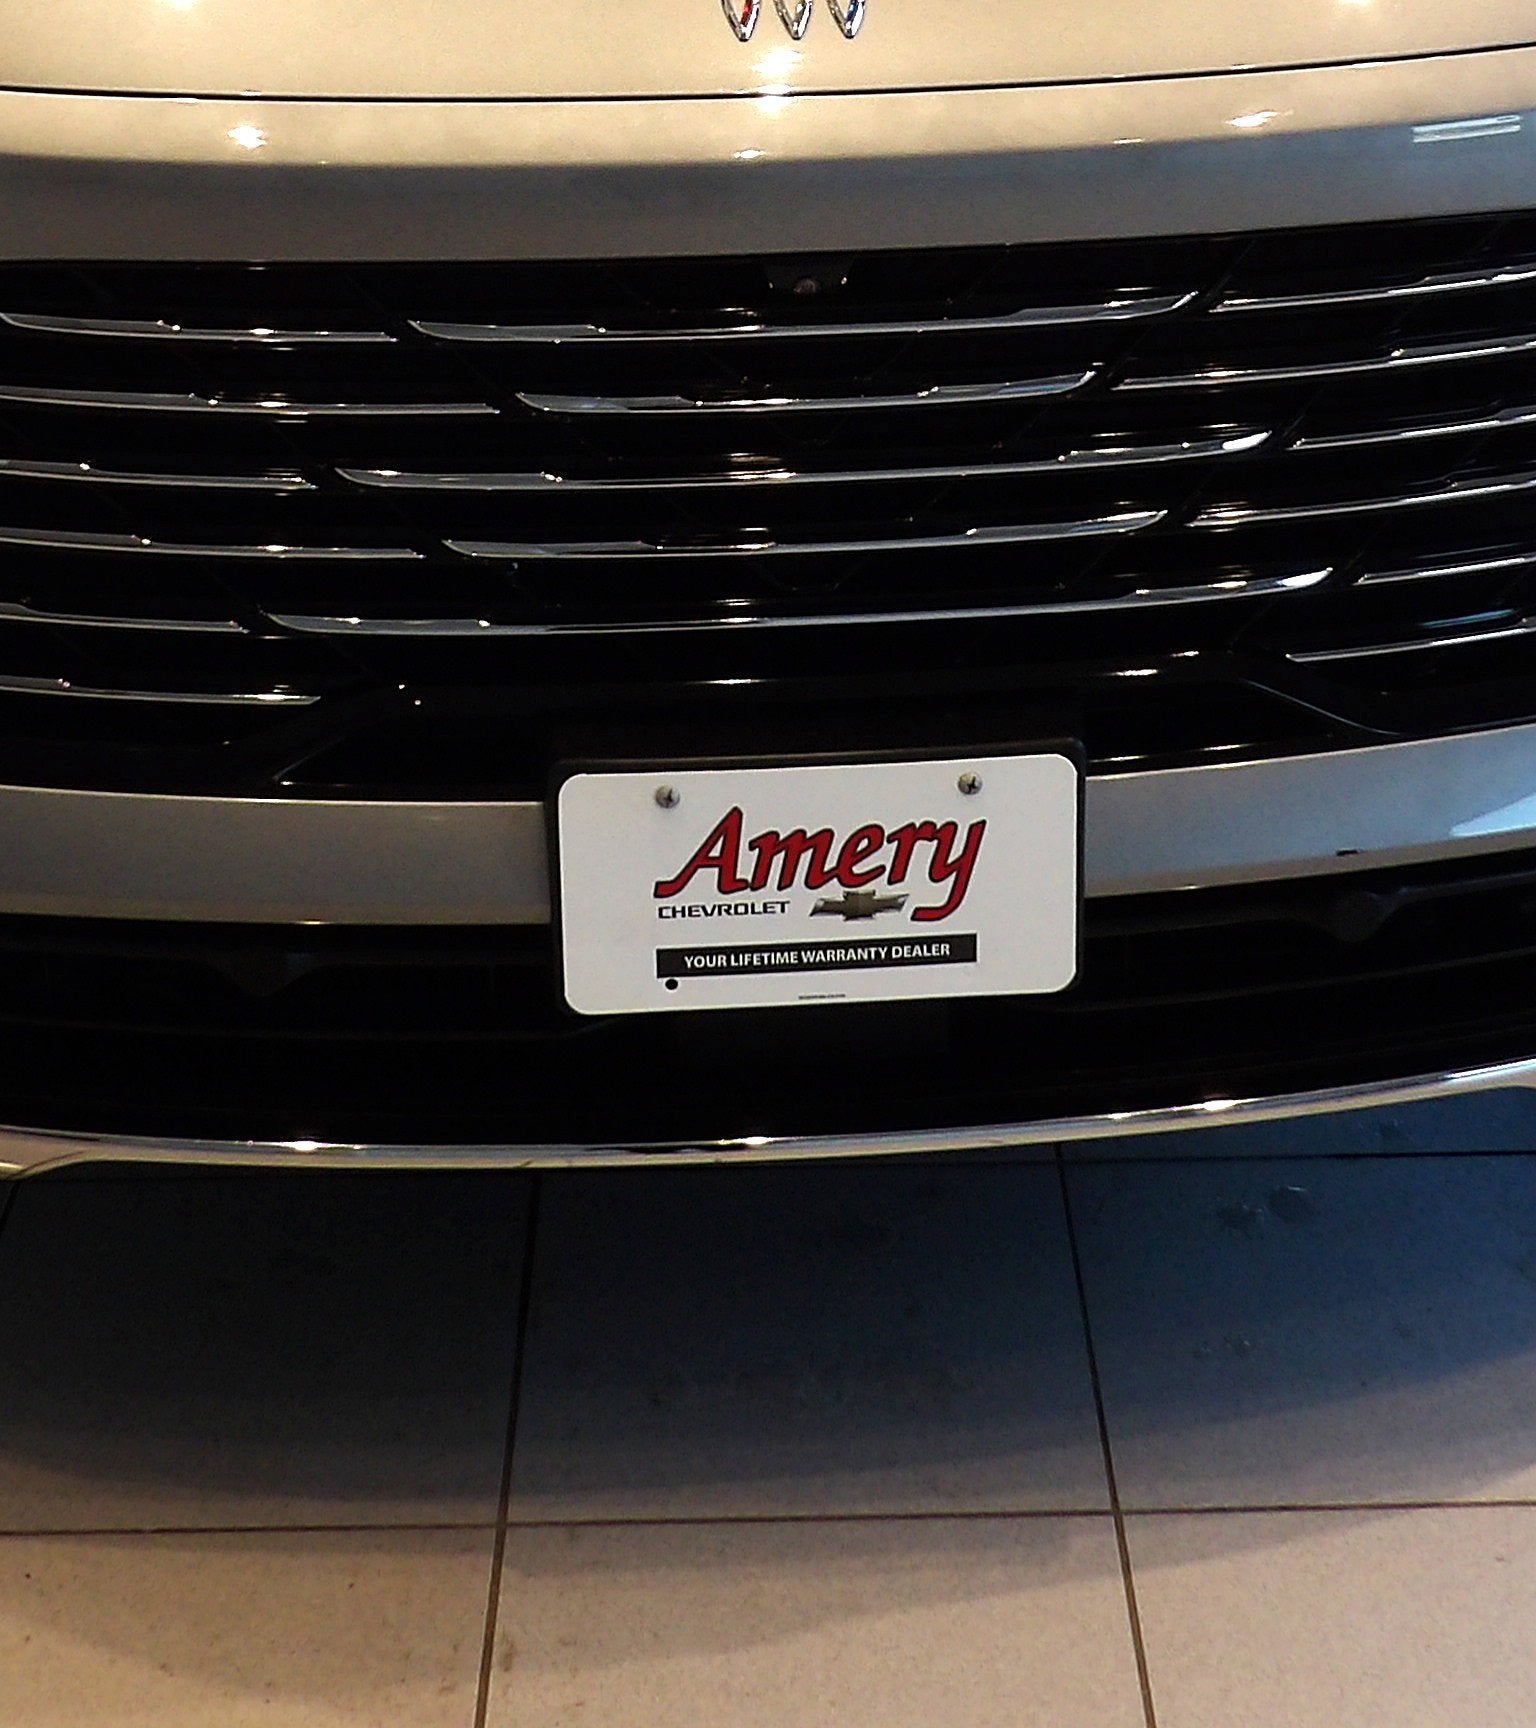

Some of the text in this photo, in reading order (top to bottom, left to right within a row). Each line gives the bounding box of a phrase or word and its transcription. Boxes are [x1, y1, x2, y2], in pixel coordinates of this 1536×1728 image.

[653, 806, 988, 922] Amery
[658, 900, 790, 919] CHEVROLET
[684, 943, 950, 969] YOUR LIFETIME WARRANTY DEALER
